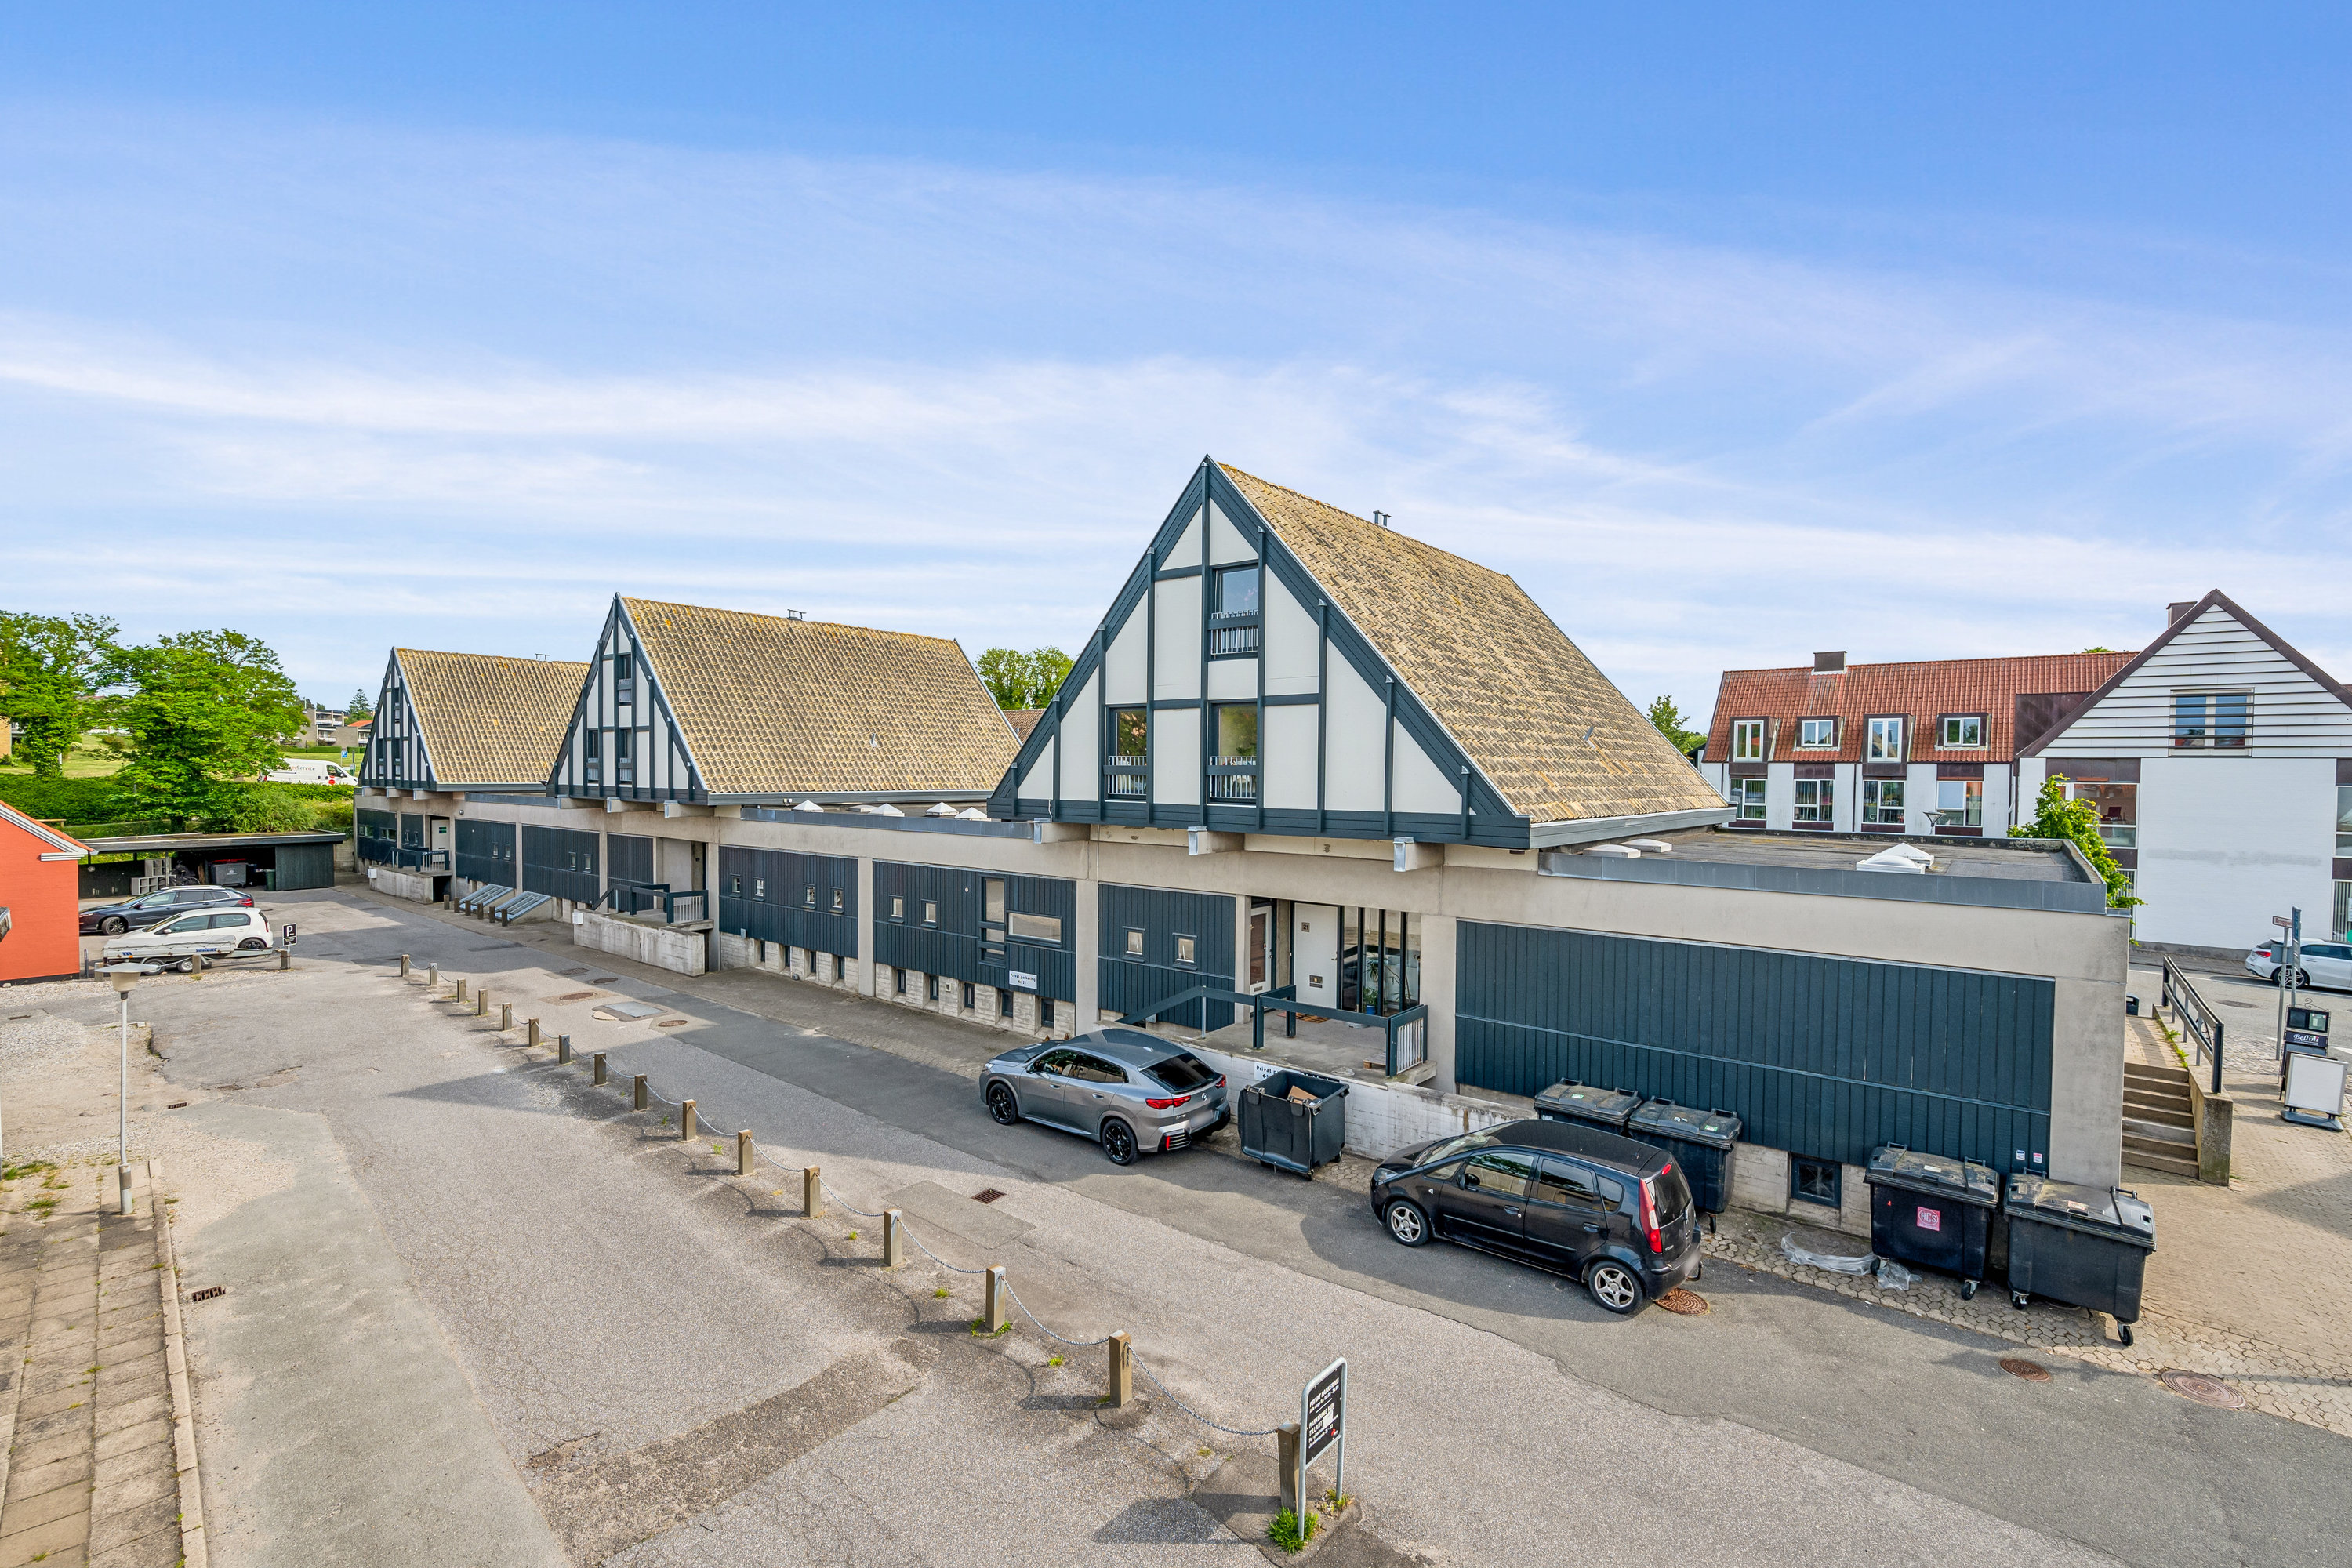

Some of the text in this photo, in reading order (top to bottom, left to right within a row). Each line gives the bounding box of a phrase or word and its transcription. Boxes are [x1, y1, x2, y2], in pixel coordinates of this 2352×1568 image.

[286, 925, 293, 937] P
[2293, 1033, 2319, 1042] Bellini
[1921, 1211, 1937, 1223] HCS
